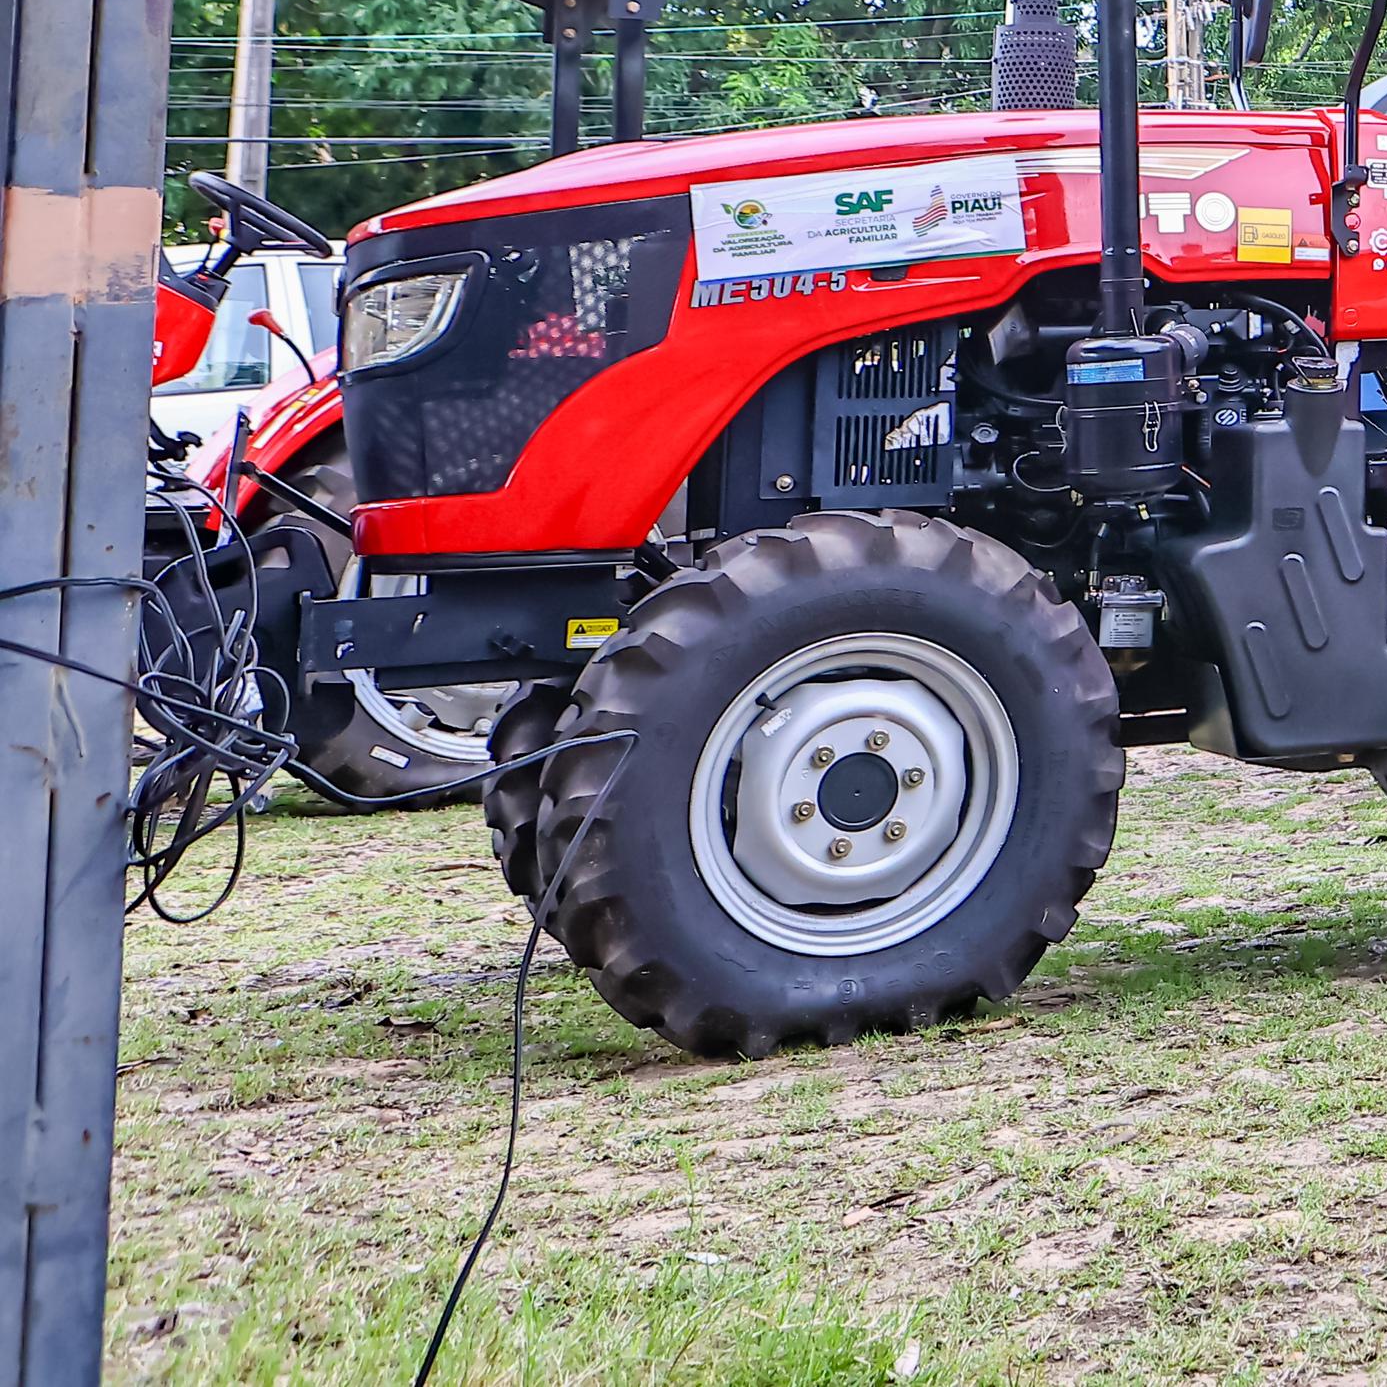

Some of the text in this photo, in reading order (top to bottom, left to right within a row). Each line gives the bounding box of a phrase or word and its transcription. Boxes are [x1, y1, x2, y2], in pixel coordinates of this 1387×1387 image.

[835, 189, 893, 215] SAF
[835, 214, 896, 227] SECRETARIA
[807, 224, 897, 239] DA AGRICULTURA
[720, 234, 785, 245] VALORIZAÇÃO
[848, 233, 898, 244] FAMILIAR
[728, 240, 793, 251] AGRICULTURA
[732, 249, 776, 257] FAMILIAR
